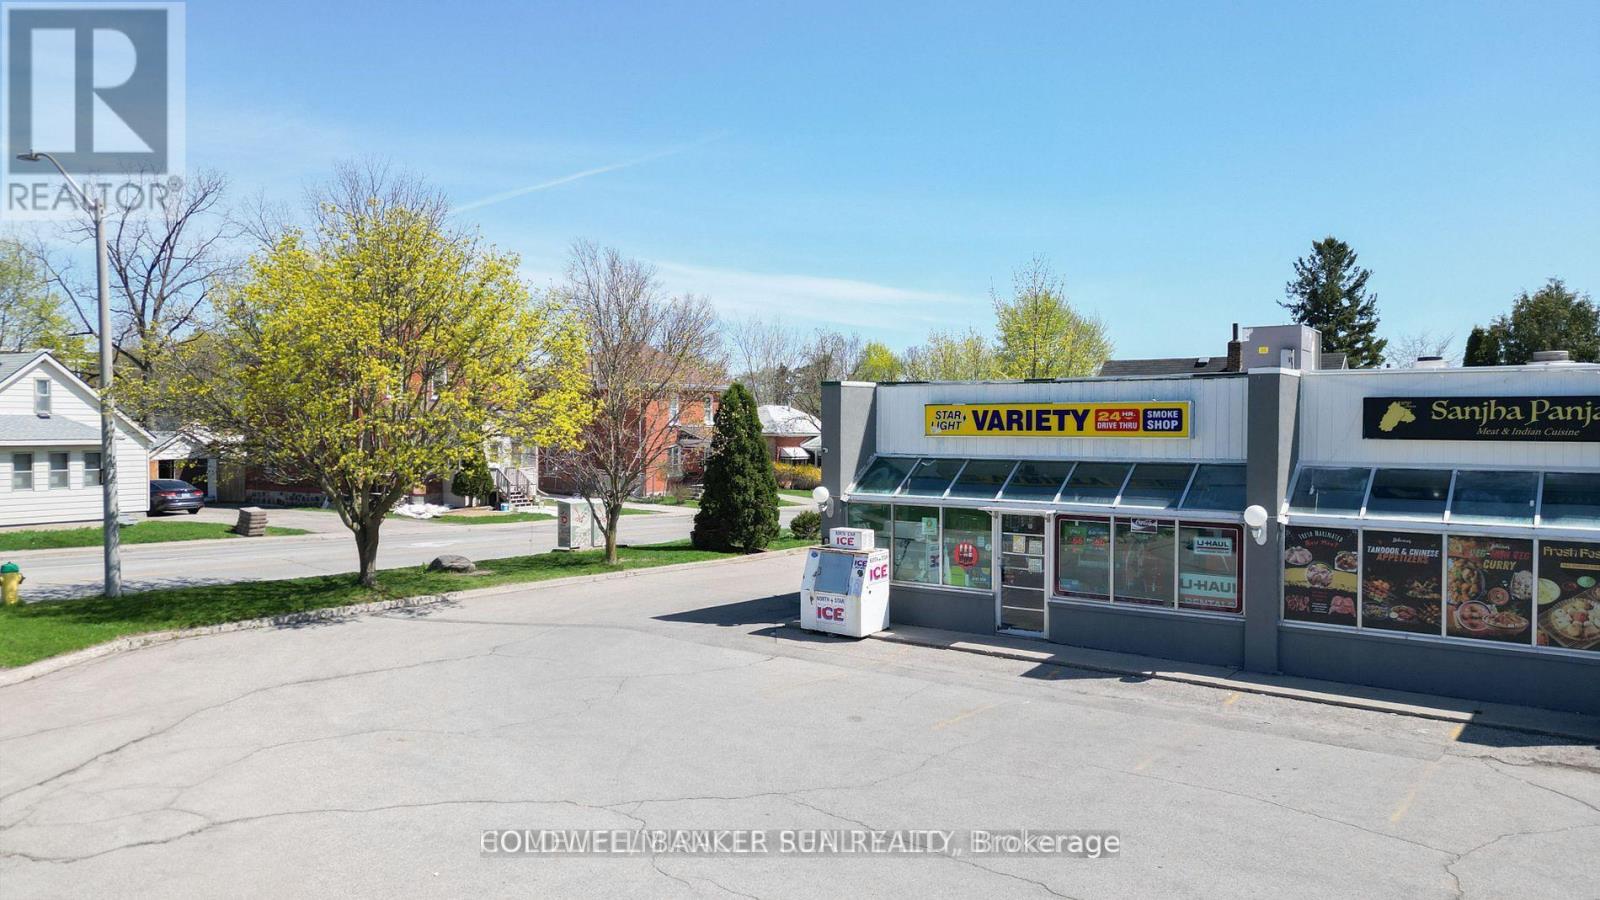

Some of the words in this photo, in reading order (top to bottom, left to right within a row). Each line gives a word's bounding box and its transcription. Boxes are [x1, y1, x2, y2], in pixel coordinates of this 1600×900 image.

[935, 410, 961, 420] STAR
[1098, 411, 1121, 421] 24
[1147, 410, 1179, 418] SMOKE
[1431, 399, 1525, 427] Sanjha
[971, 409, 1091, 432] VARIETY
[1097, 421, 1118, 429] DRIVE
[1119, 421, 1138, 429] THRU
[1147, 420, 1179, 430] SHOP
[1476, 427, 1499, 435] Meat
[1501, 427, 1510, 435] &
[1511, 427, 1541, 436] Indian
[1544, 427, 1580, 436] Cuisine
[836, 537, 855, 546] ICE
[1483, 559, 1517, 570] CURRY
[870, 564, 888, 580] ICE
[816, 606, 844, 621] ICE
